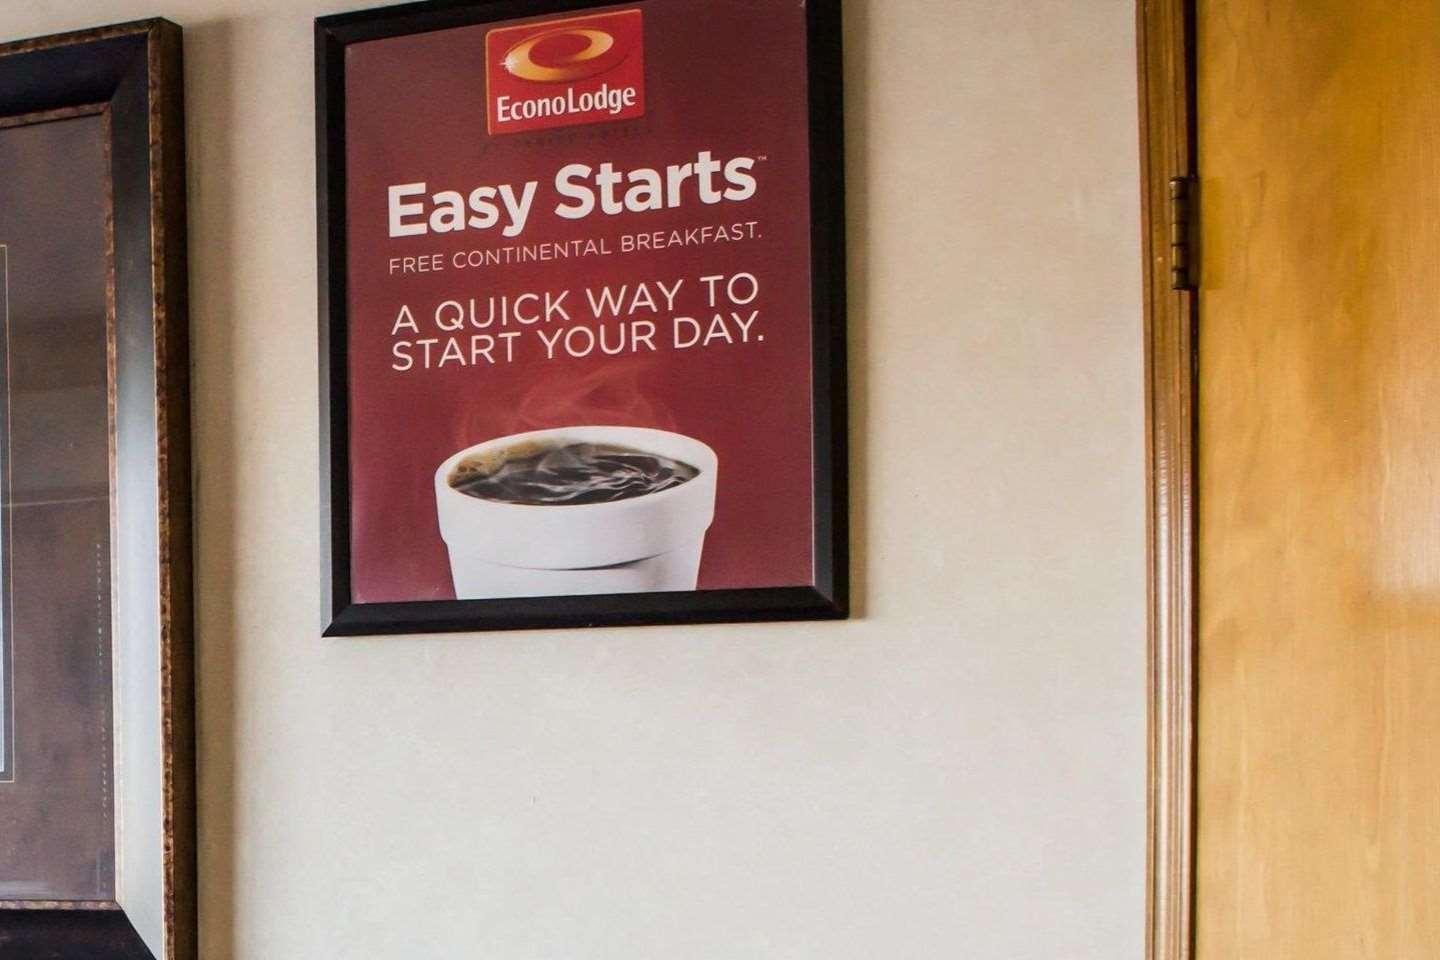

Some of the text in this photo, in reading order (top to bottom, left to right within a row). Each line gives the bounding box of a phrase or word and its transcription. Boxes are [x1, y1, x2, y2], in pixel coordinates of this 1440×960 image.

[496, 83, 637, 122] EconoLodge
[388, 180, 538, 238] Easy
[389, 220, 762, 275] FREE CONTINENTAL BREAKFAST.
[392, 272, 759, 335] A QUICK WAY TO
[392, 310, 764, 371] START YOUR DAY.
